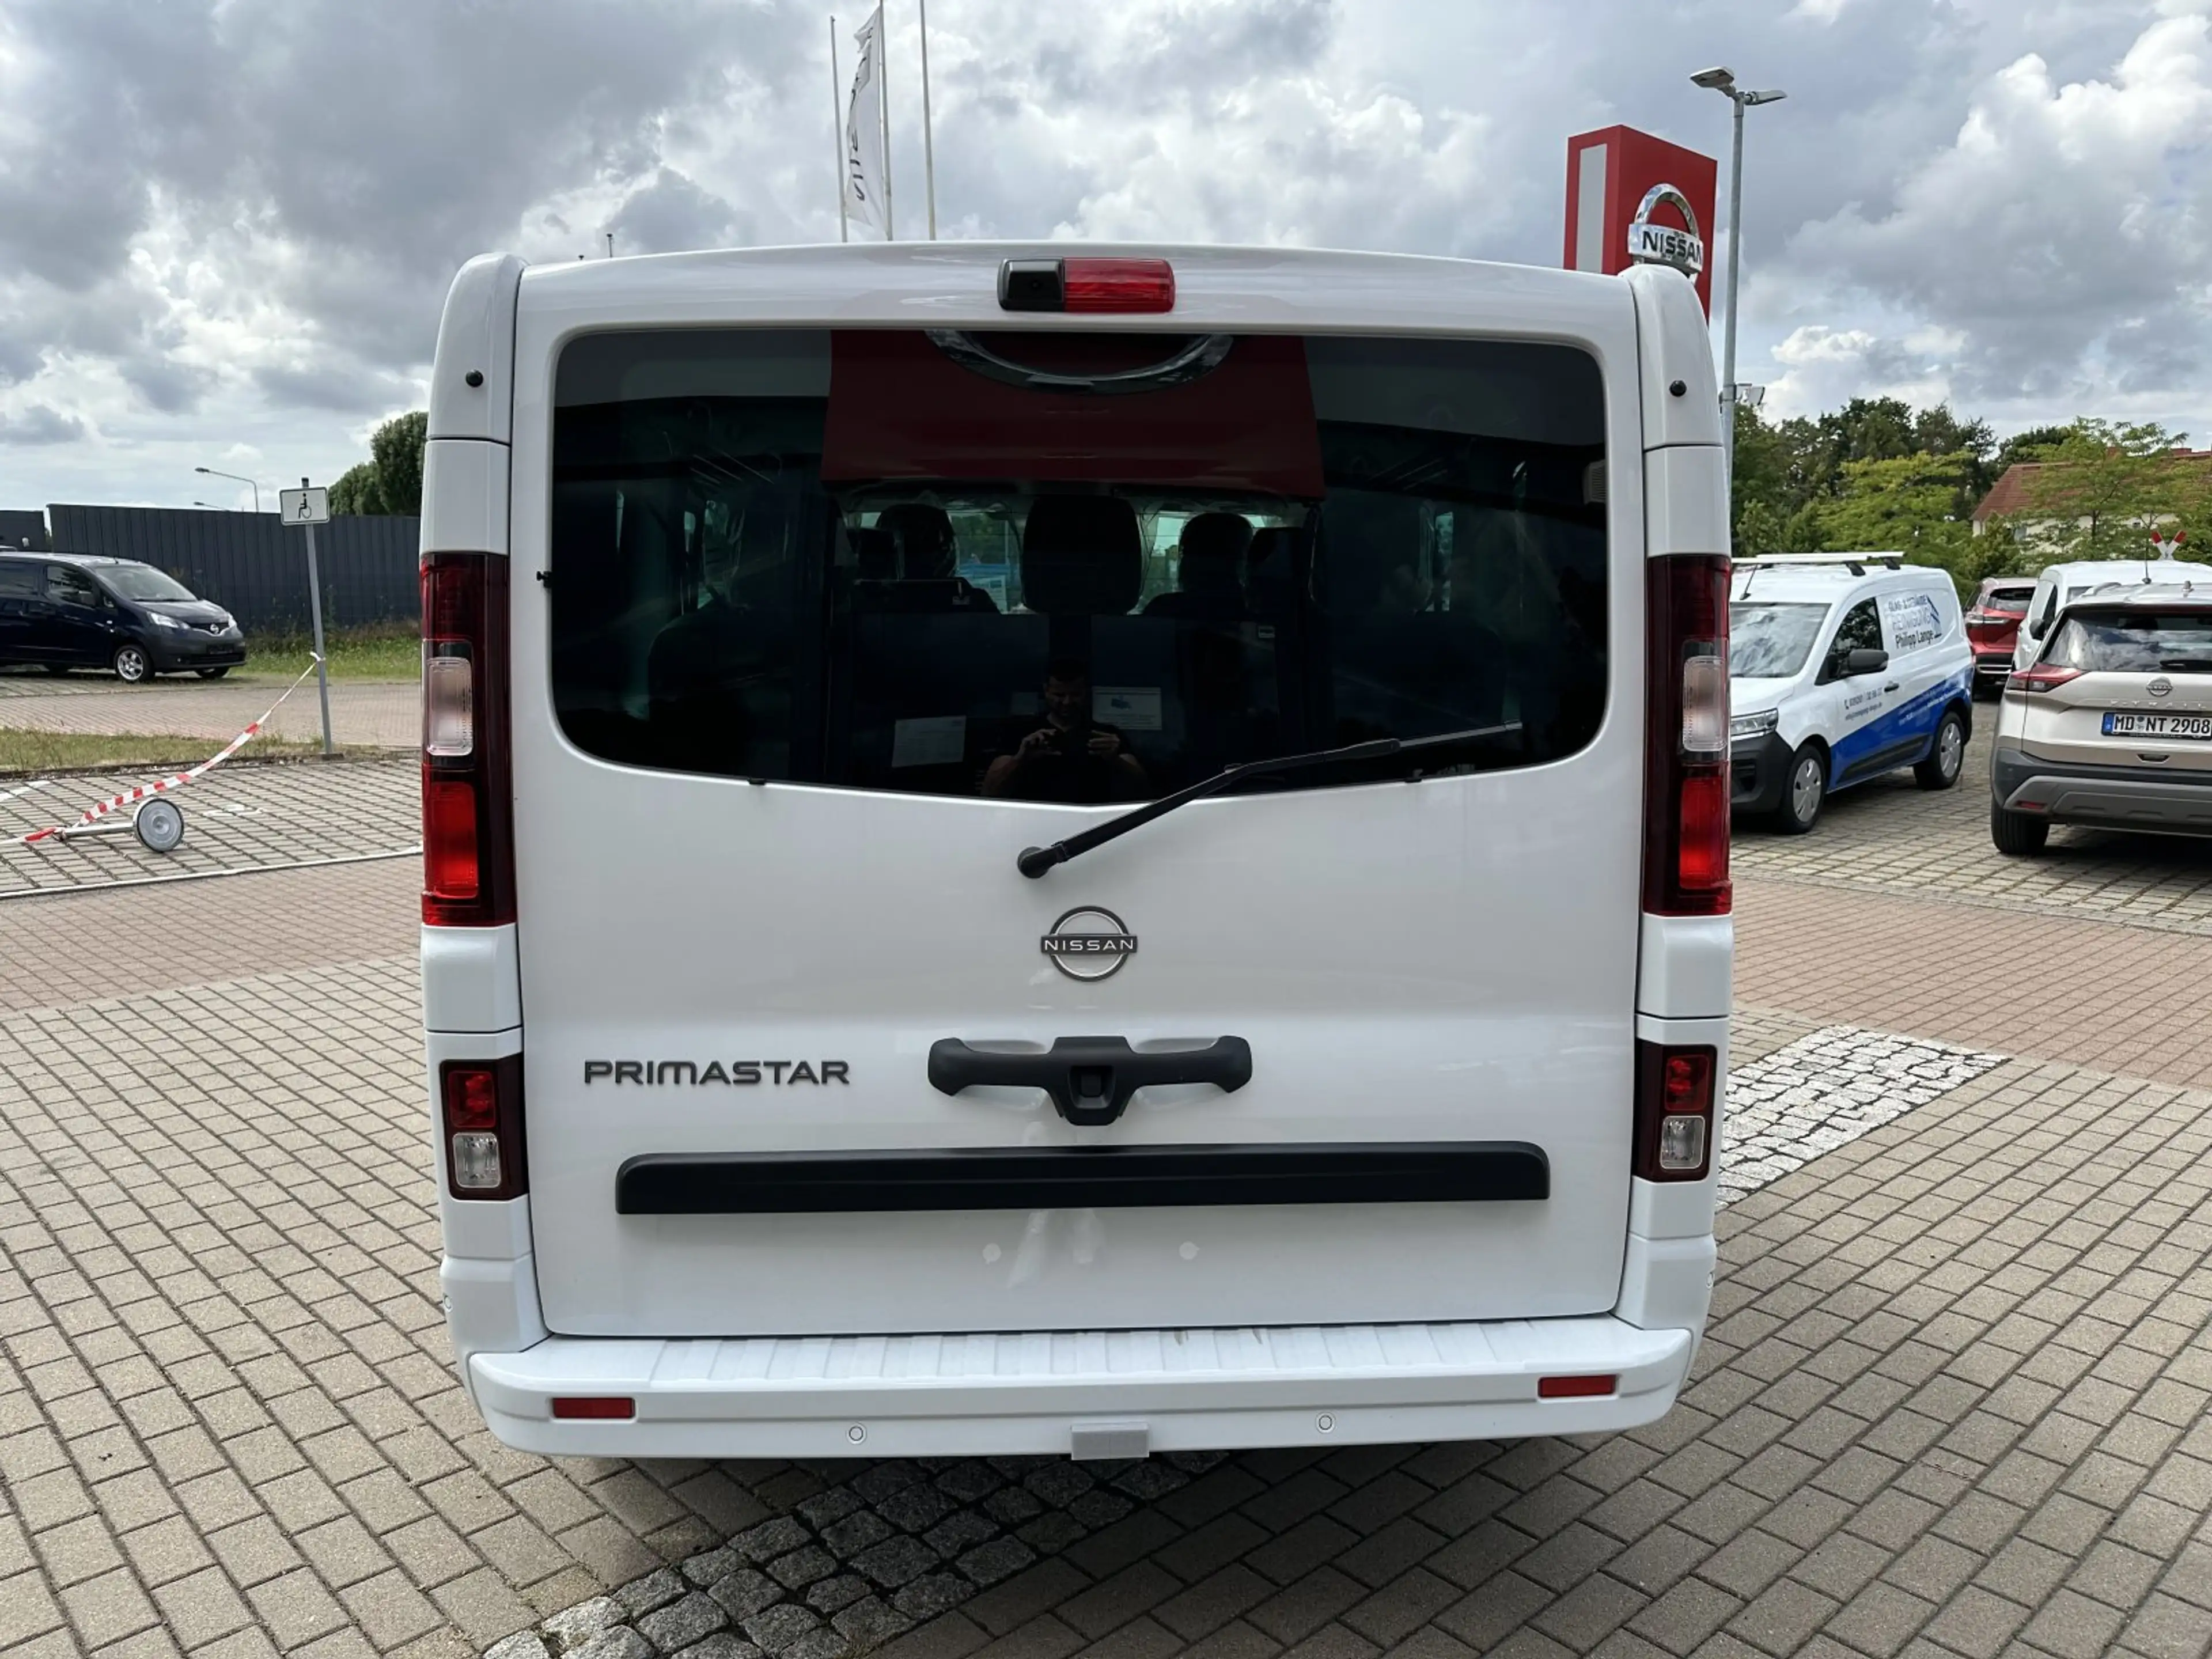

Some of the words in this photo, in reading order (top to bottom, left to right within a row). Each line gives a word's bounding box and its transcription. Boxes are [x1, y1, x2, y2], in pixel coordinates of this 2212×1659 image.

[1642, 230, 1702, 263] NISSAN
[2114, 715, 2135, 731] MD
[2145, 717, 2167, 732] NT
[2170, 718, 2210, 734] 2908
[1044, 940, 1133, 950] NISSAN
[584, 1060, 850, 1085] PRIMASTAR
